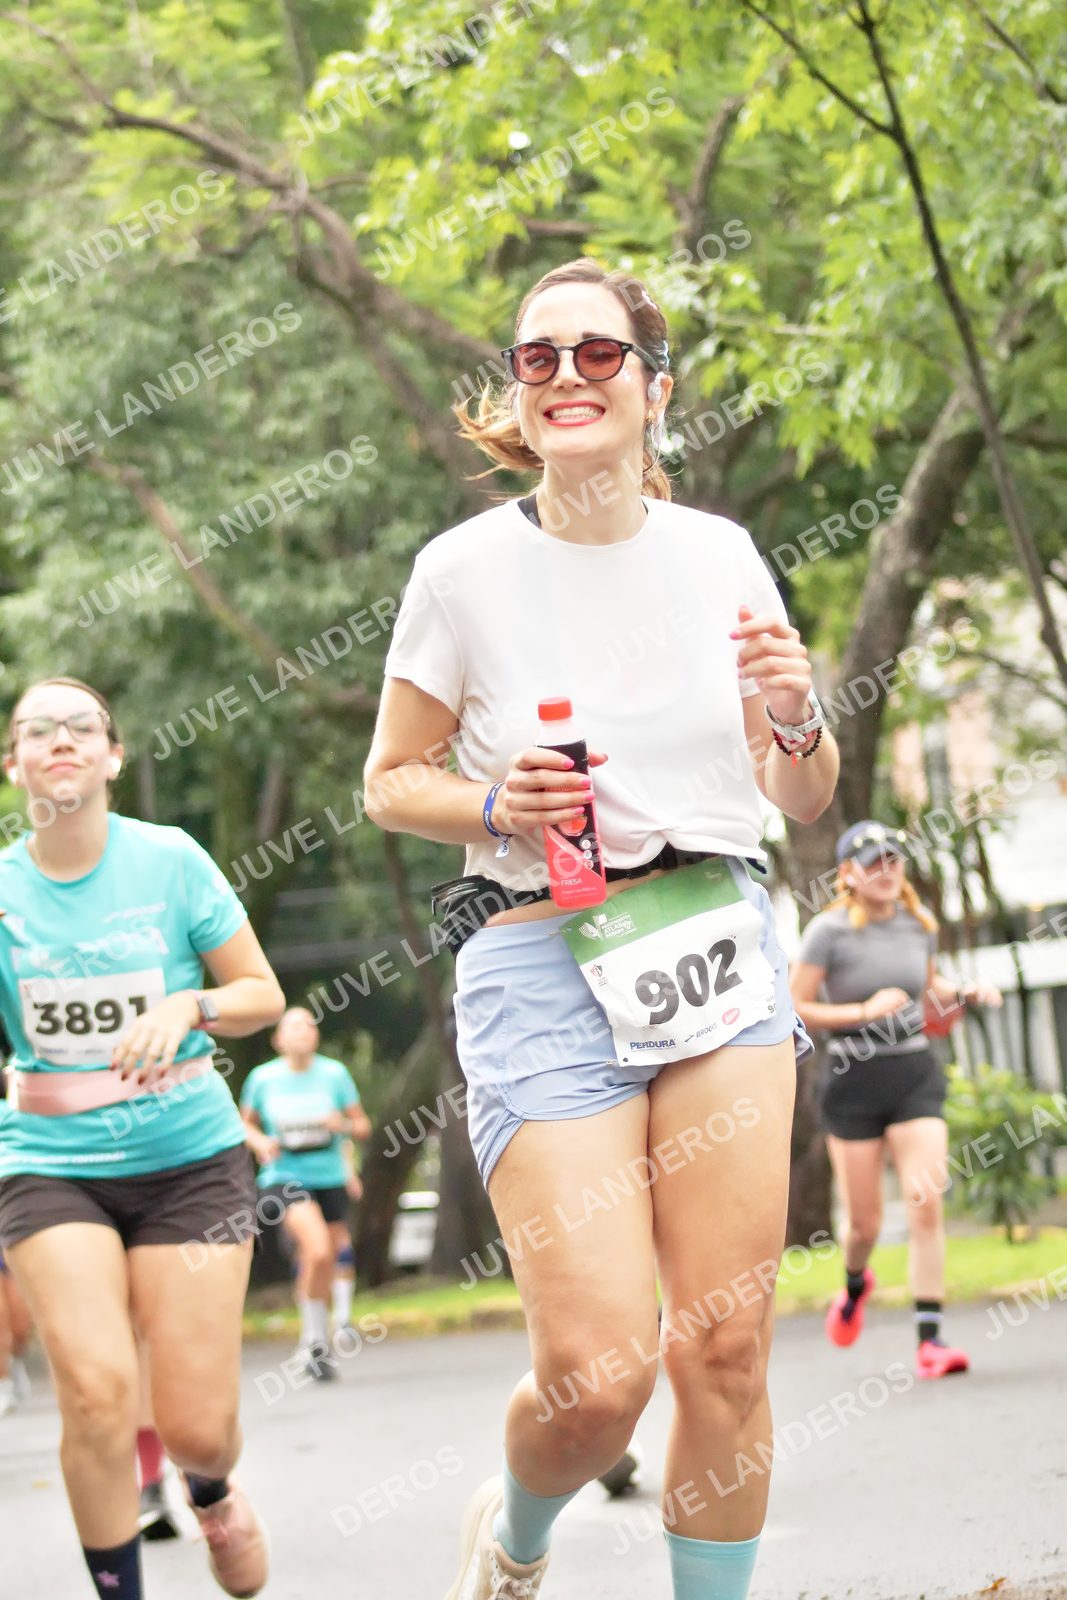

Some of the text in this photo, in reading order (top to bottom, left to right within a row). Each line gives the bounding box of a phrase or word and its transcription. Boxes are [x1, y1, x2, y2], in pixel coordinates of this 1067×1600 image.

[560, 878, 582, 887] FRESA
[635, 938, 743, 1025] 902
[33, 995, 148, 1036] 3891
[629, 1038, 676, 1051] PERDURA
